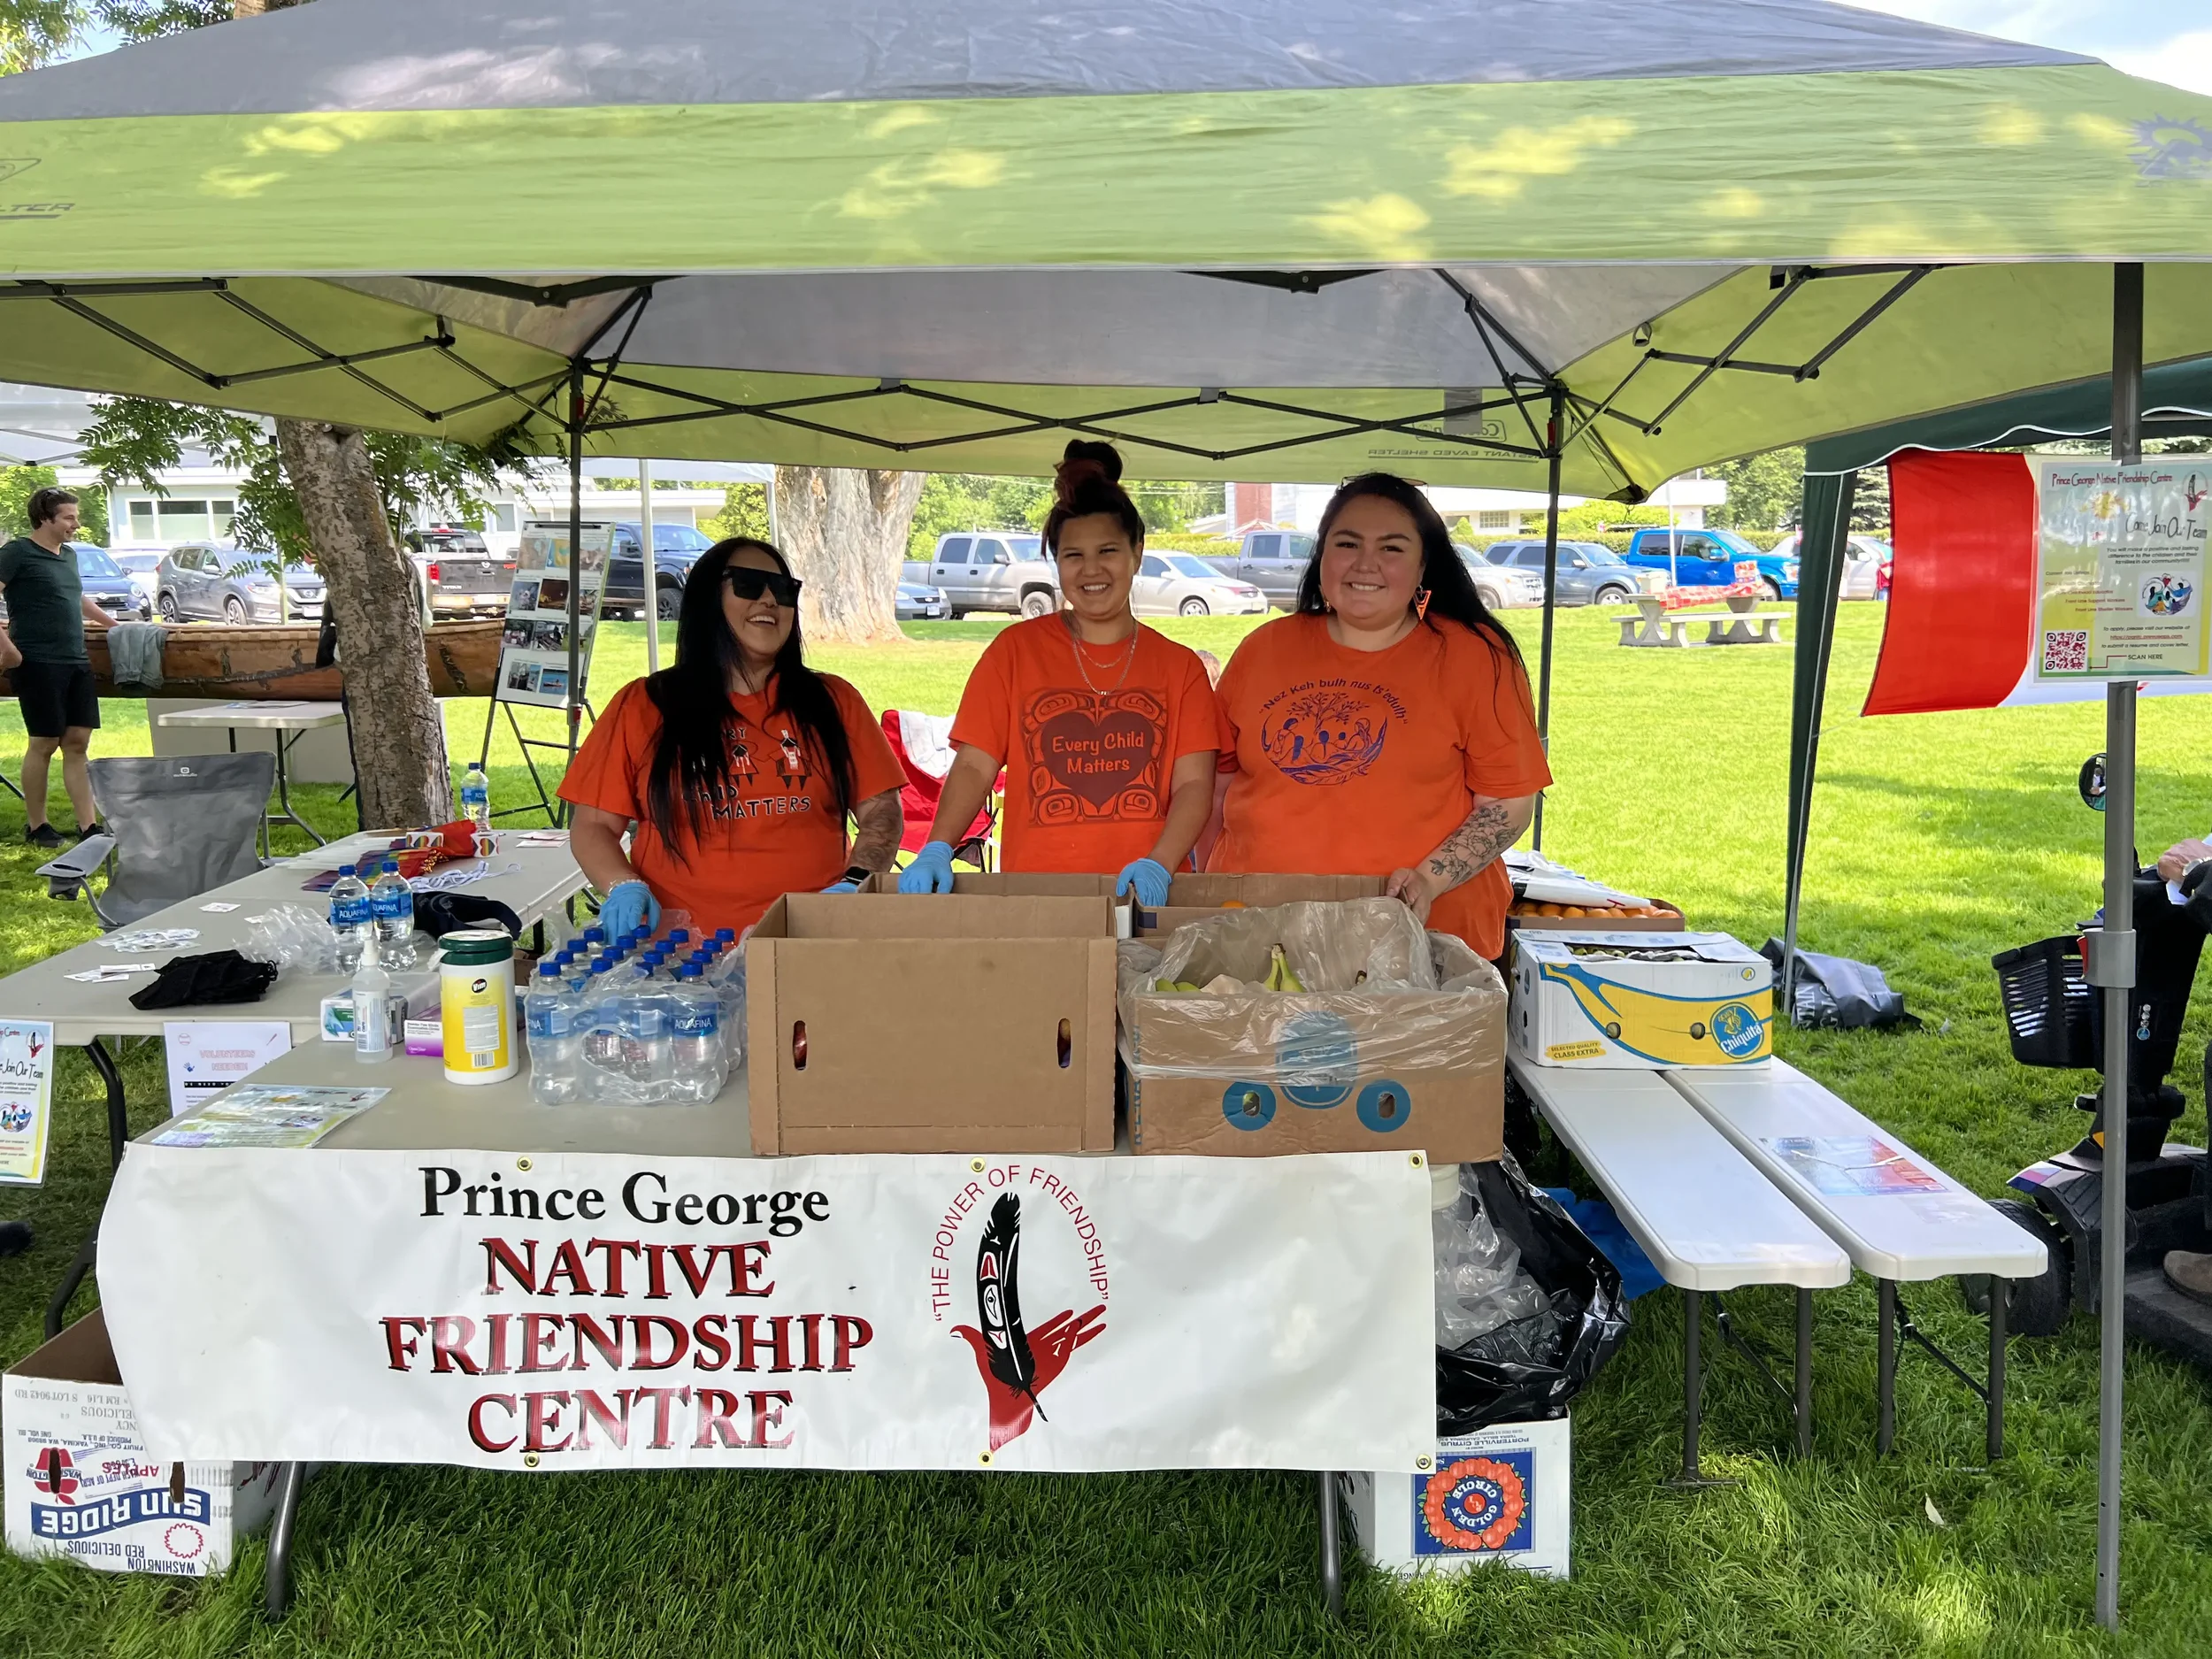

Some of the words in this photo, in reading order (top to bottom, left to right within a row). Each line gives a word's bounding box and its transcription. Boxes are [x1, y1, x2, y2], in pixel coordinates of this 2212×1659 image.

[2052, 472, 2070, 487] Prince
[2071, 472, 2095, 488] George
[2096, 472, 2116, 484] Native
[2117, 471, 2149, 486] Friendship
[2150, 470, 2172, 484] Centre
[2148, 514, 2167, 535] Join
[2186, 519, 2208, 540] Team
[1289, 681, 1315, 694] Keh
[1319, 678, 1347, 687] bulh
[1349, 681, 1371, 690] nus
[1052, 735, 1100, 756] Every
[1103, 731, 1144, 749] Child
[1066, 757, 1131, 774] Matters
[710, 796, 810, 820] MATTERS
[472, 979, 487, 992] Vim
[1720, 1022, 1763, 1053] Chiquita
[199, 1049, 255, 1058] VOLUNTEERS
[1554, 1049, 1575, 1059] CLASS
[1576, 1048, 1599, 1056] EXTRA
[2, 1058, 15, 1073] Join
[16, 1061, 28, 1077] Our
[29, 1064, 43, 1079] Team
[418, 1167, 605, 1221] Prince
[621, 1171, 830, 1237] George
[932, 1181, 985, 1261] POWER
[987, 1164, 1020, 1187] OF
[480, 1237, 775, 1299] NATIVE
[379, 1312, 873, 1376] FRIENDSHIP
[105, 1395, 120, 1405] RM
[467, 1384, 795, 1453] CENTRE
[107, 1435, 132, 1444] PRODUCE
[1475, 1437, 1529, 1446] PORTERVILLE
[103, 1461, 159, 1477] APPLES
[96, 1475, 104, 1485] OF
[1452, 1480, 1497, 1500] CIRCLE
[41, 1497, 131, 1533] RIDGE
[1451, 1504, 1497, 1527] GOLDEN
[68, 1541, 121, 1556] DELICIOUS
[125, 1544, 145, 1558] RED
[127, 1557, 196, 1575] WASHINGTON
